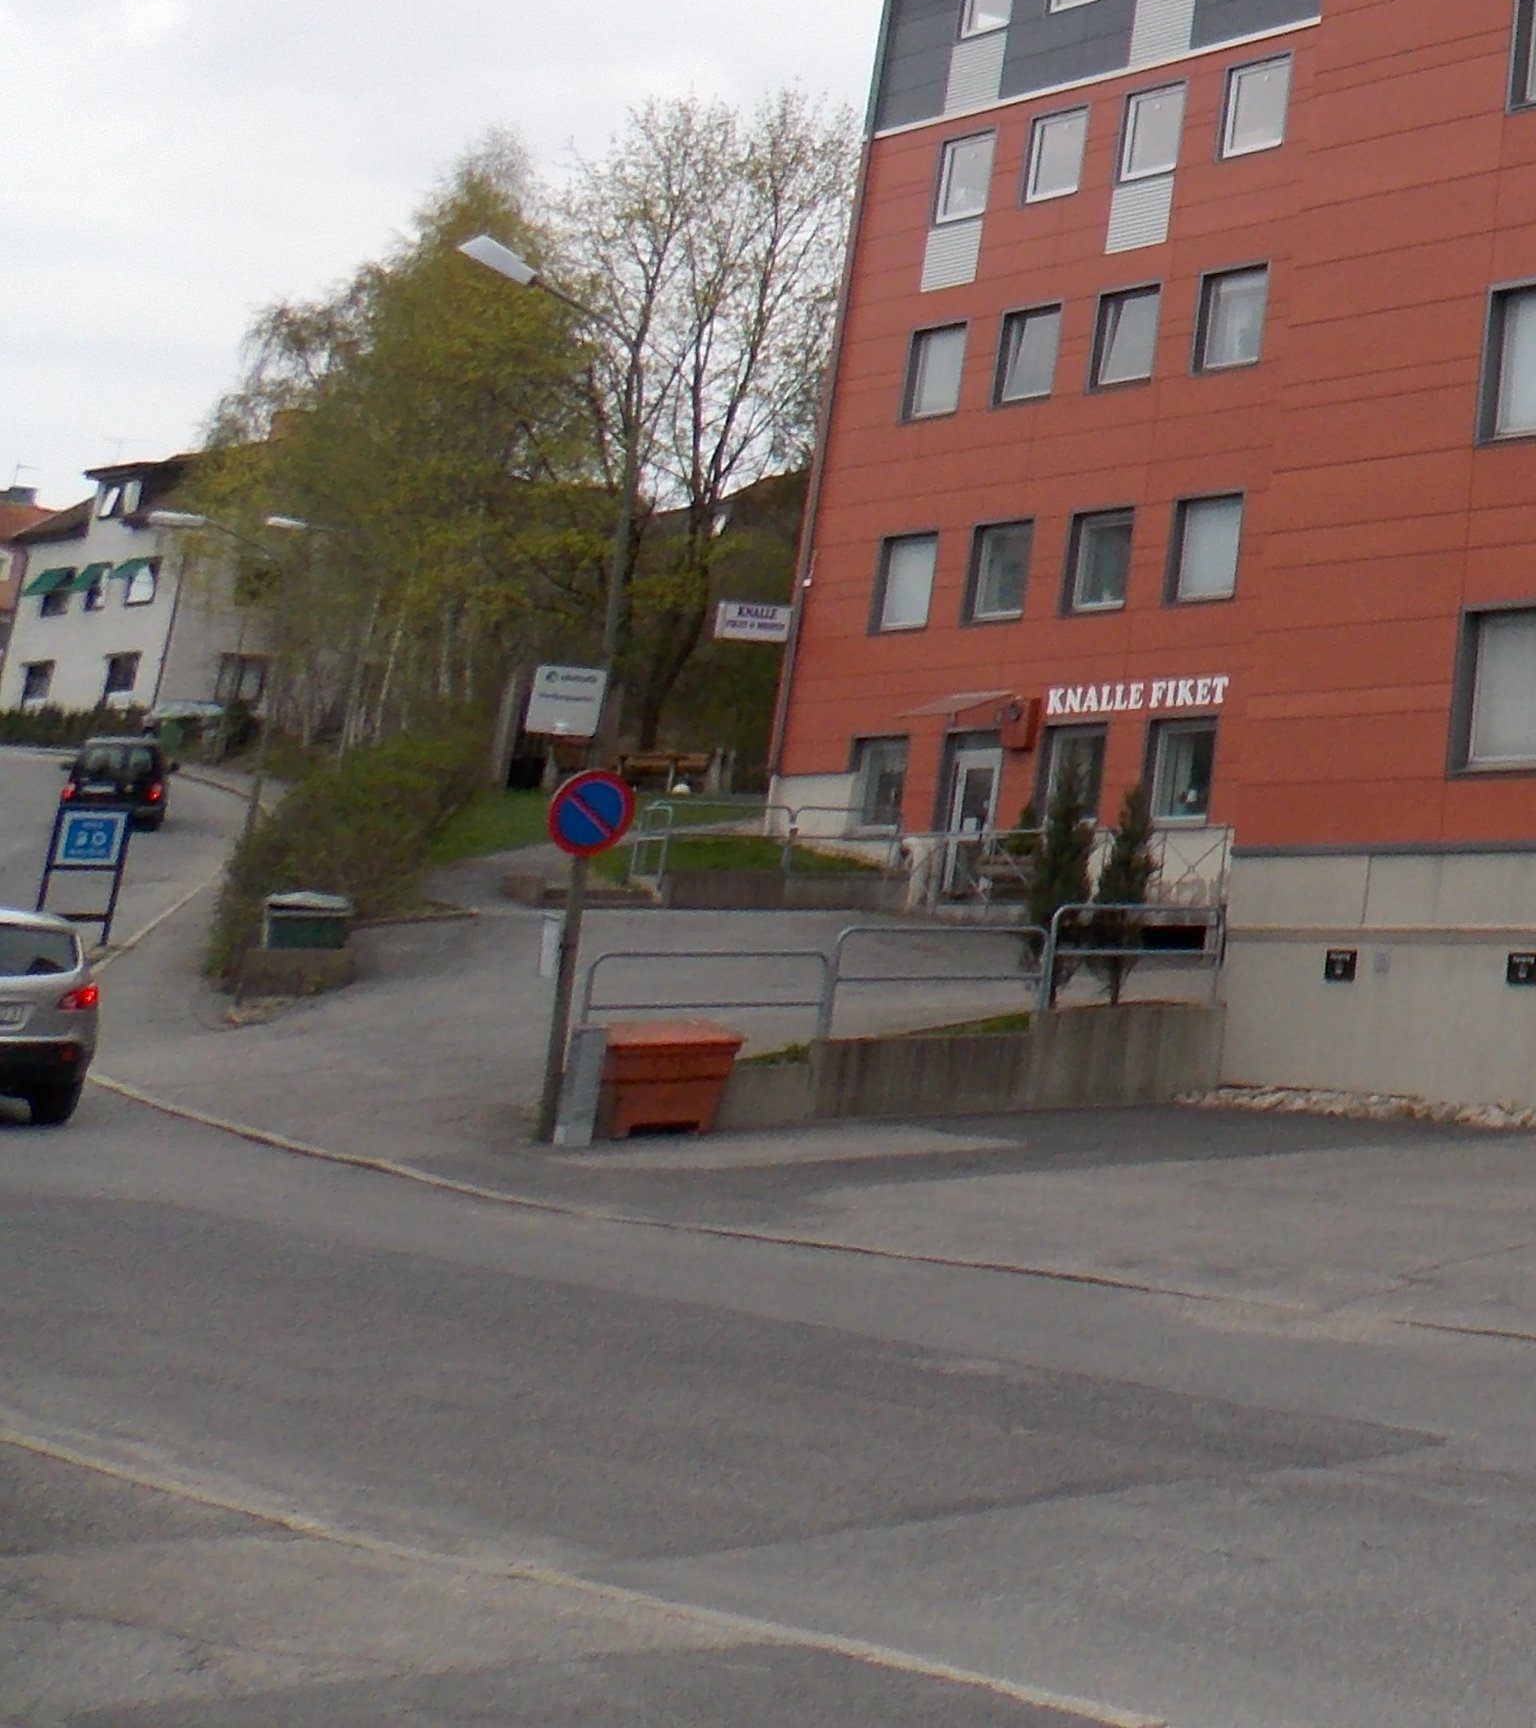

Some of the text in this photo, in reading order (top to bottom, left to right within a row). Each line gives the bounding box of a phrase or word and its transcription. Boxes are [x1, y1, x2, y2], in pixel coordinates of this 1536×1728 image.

[737, 606, 778, 619] KNALLE
[1046, 676, 1229, 714] KNALLE FIKET
